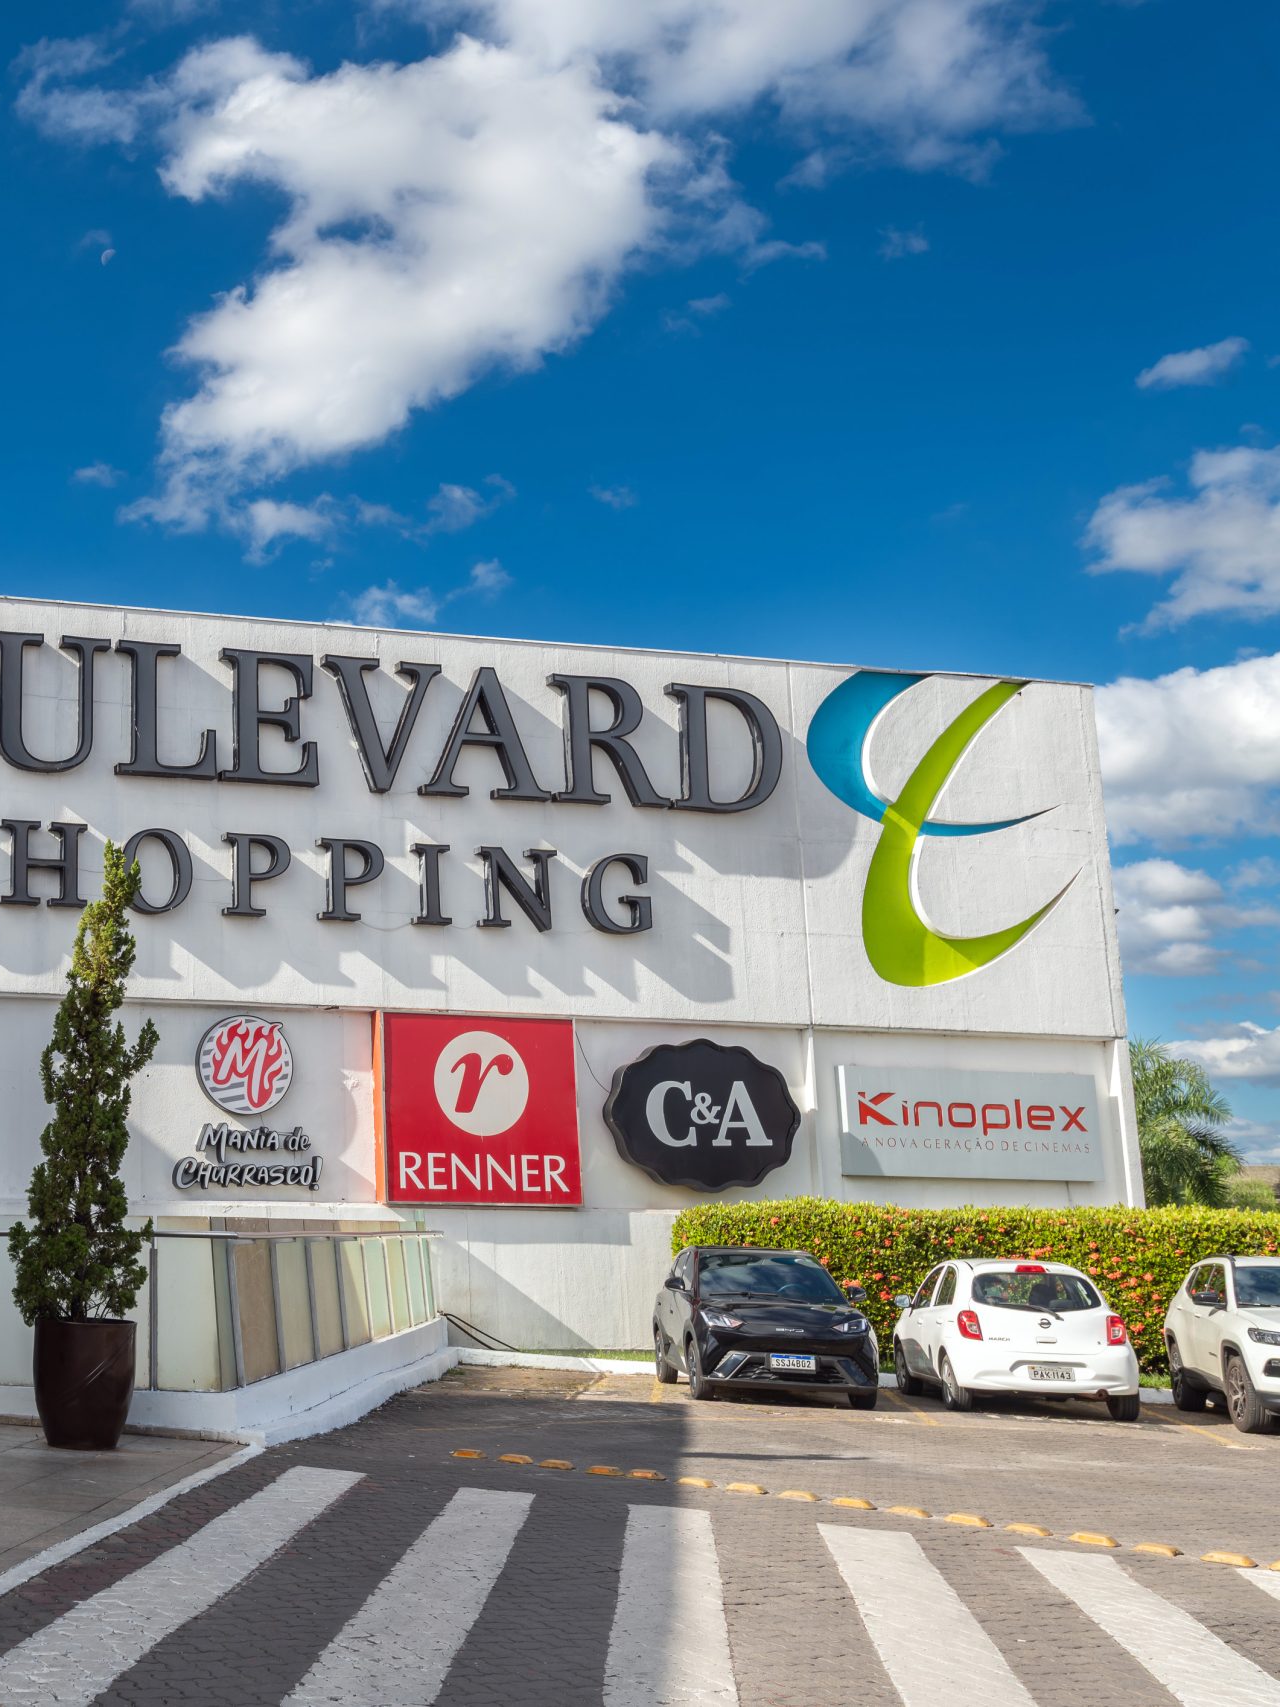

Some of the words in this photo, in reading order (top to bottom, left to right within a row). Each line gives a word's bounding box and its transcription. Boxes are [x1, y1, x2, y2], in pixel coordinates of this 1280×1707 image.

[645, 1080, 773, 1147] C&A
[857, 1091, 1089, 1137] Kinoplex
[284, 1126, 312, 1151] de
[861, 1136, 870, 1148] A
[874, 1137, 919, 1149] NOVA
[923, 1137, 995, 1153] GERAÇÃO
[1001, 1140, 1019, 1151] DE
[1023, 1141, 1091, 1154] CINEMAS
[398, 1151, 570, 1193] RENNER
